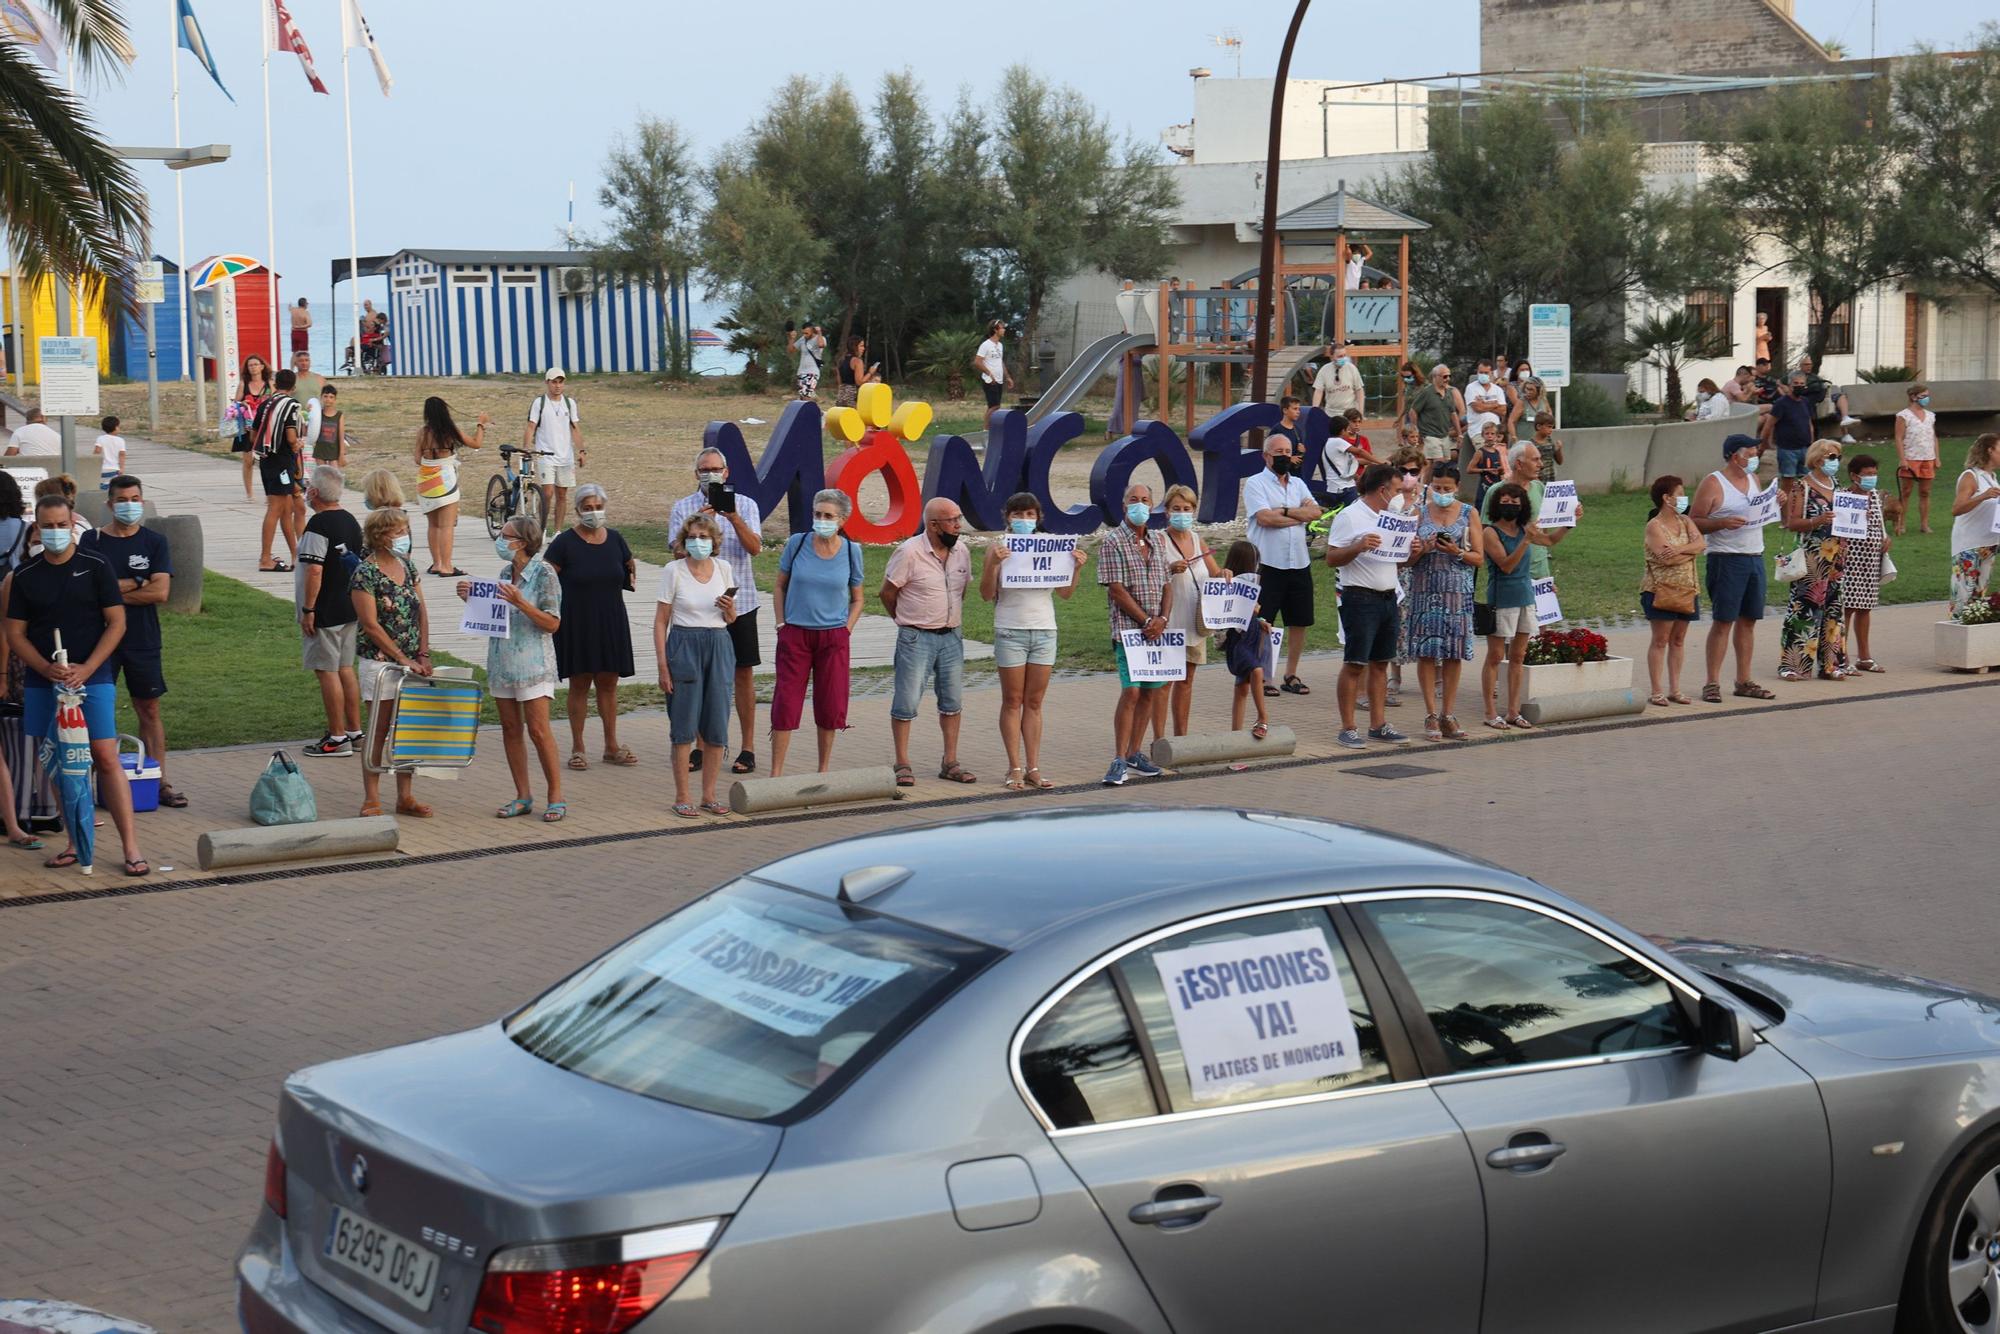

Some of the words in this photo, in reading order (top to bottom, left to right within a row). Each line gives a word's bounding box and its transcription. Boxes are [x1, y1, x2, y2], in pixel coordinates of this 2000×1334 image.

[1007, 538, 1076, 552] ¡ESPIGONES
[1032, 557, 1052, 571] YA!
[1006, 575, 1032, 583] PLATGES
[1034, 575, 1042, 583] DE
[491, 604, 506, 620] YA!
[1147, 651, 1162, 665] YA!
[688, 928, 839, 998] ¡ESPIGONES
[823, 975, 882, 1006] YA!
[1175, 947, 1331, 1010] ¡ESPIGONES
[1246, 1001, 1297, 1040] YA!
[1202, 1056, 1260, 1082] PLATGES
[1263, 1053, 1281, 1072] DE
[1283, 1040, 1345, 1067] MONCOFA
[336, 1217, 388, 1274] 6295
[389, 1243, 435, 1298] DGJ
